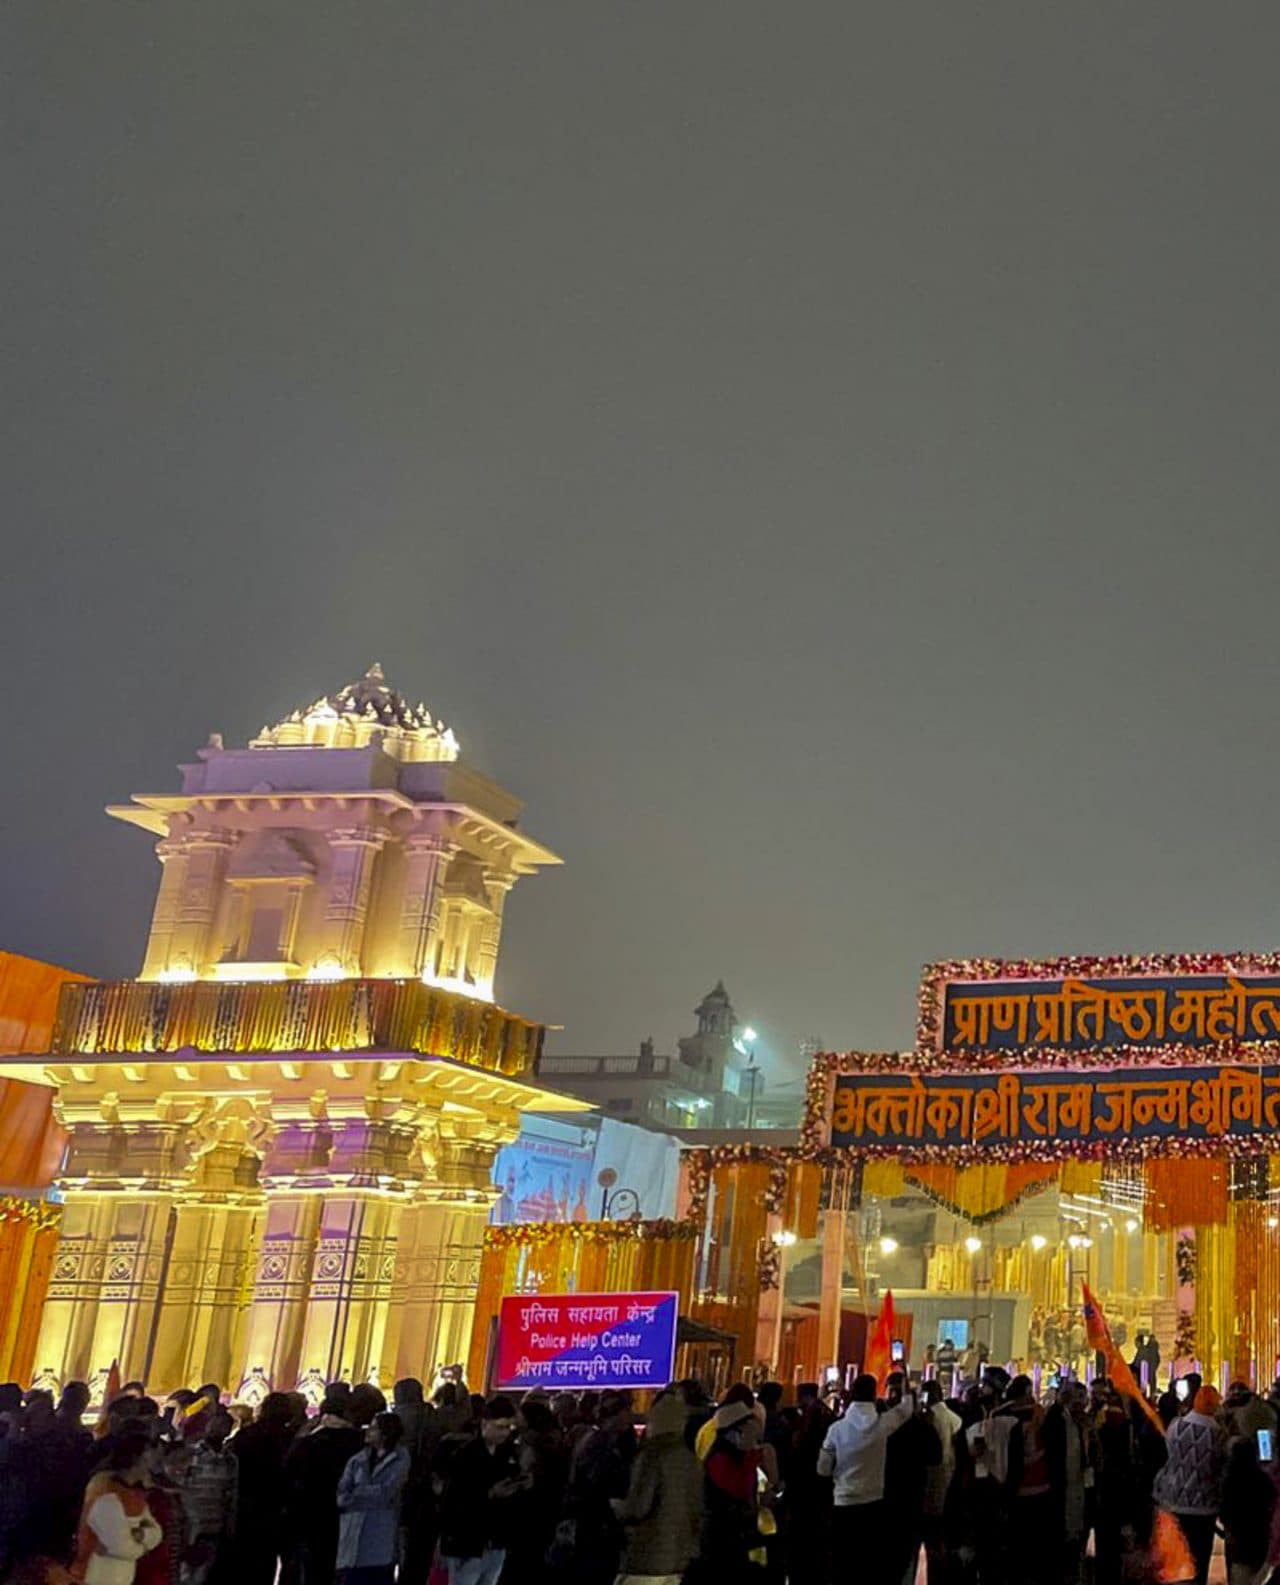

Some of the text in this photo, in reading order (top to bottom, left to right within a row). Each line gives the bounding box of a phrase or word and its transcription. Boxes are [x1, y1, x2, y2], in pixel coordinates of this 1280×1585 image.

[949, 994, 1031, 1046] प्राण
[1033, 978, 1166, 1042] प्रतिष्ठा
[926, 1088, 974, 1139] का
[972, 1074, 1020, 1141] श्री
[1022, 1083, 1094, 1136] राम
[521, 1302, 657, 1331] पुलिस सहायता केन्द्र
[531, 1331, 641, 1351] Police Help Center
[555, 1355, 608, 1380] जन्मभूमि
[611, 1355, 652, 1376] परिसर
